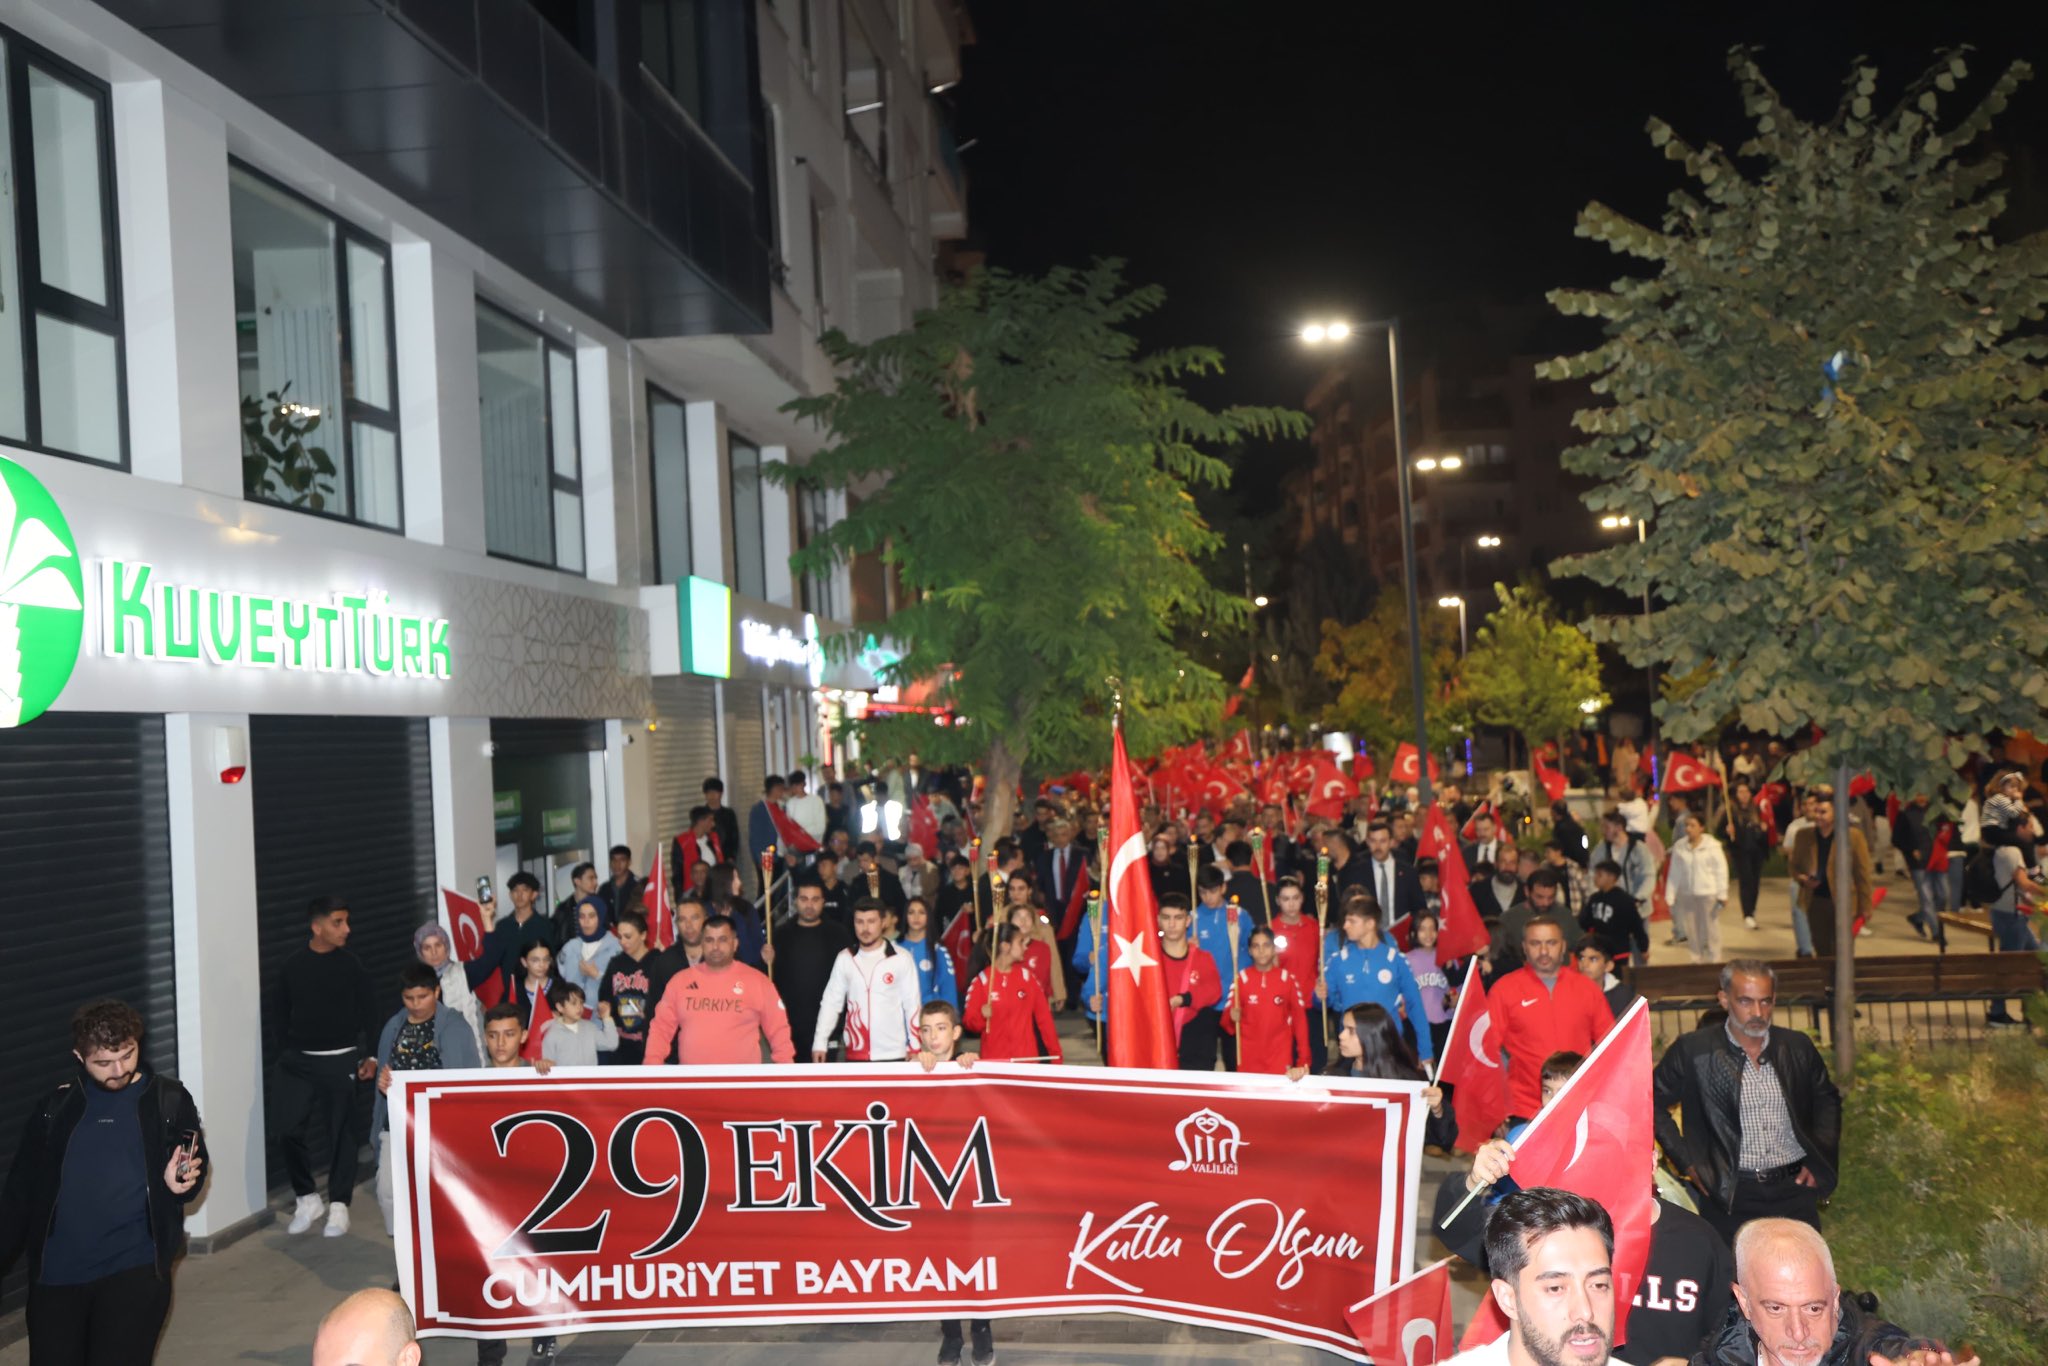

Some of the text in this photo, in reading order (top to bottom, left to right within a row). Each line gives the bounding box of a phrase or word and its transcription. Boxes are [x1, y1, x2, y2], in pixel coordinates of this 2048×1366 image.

[491, 1101, 1012, 1259] 29 EKİM
[796, 1256, 998, 1294] BAYRAMI
[1066, 1201, 1183, 1293] Kutlu
